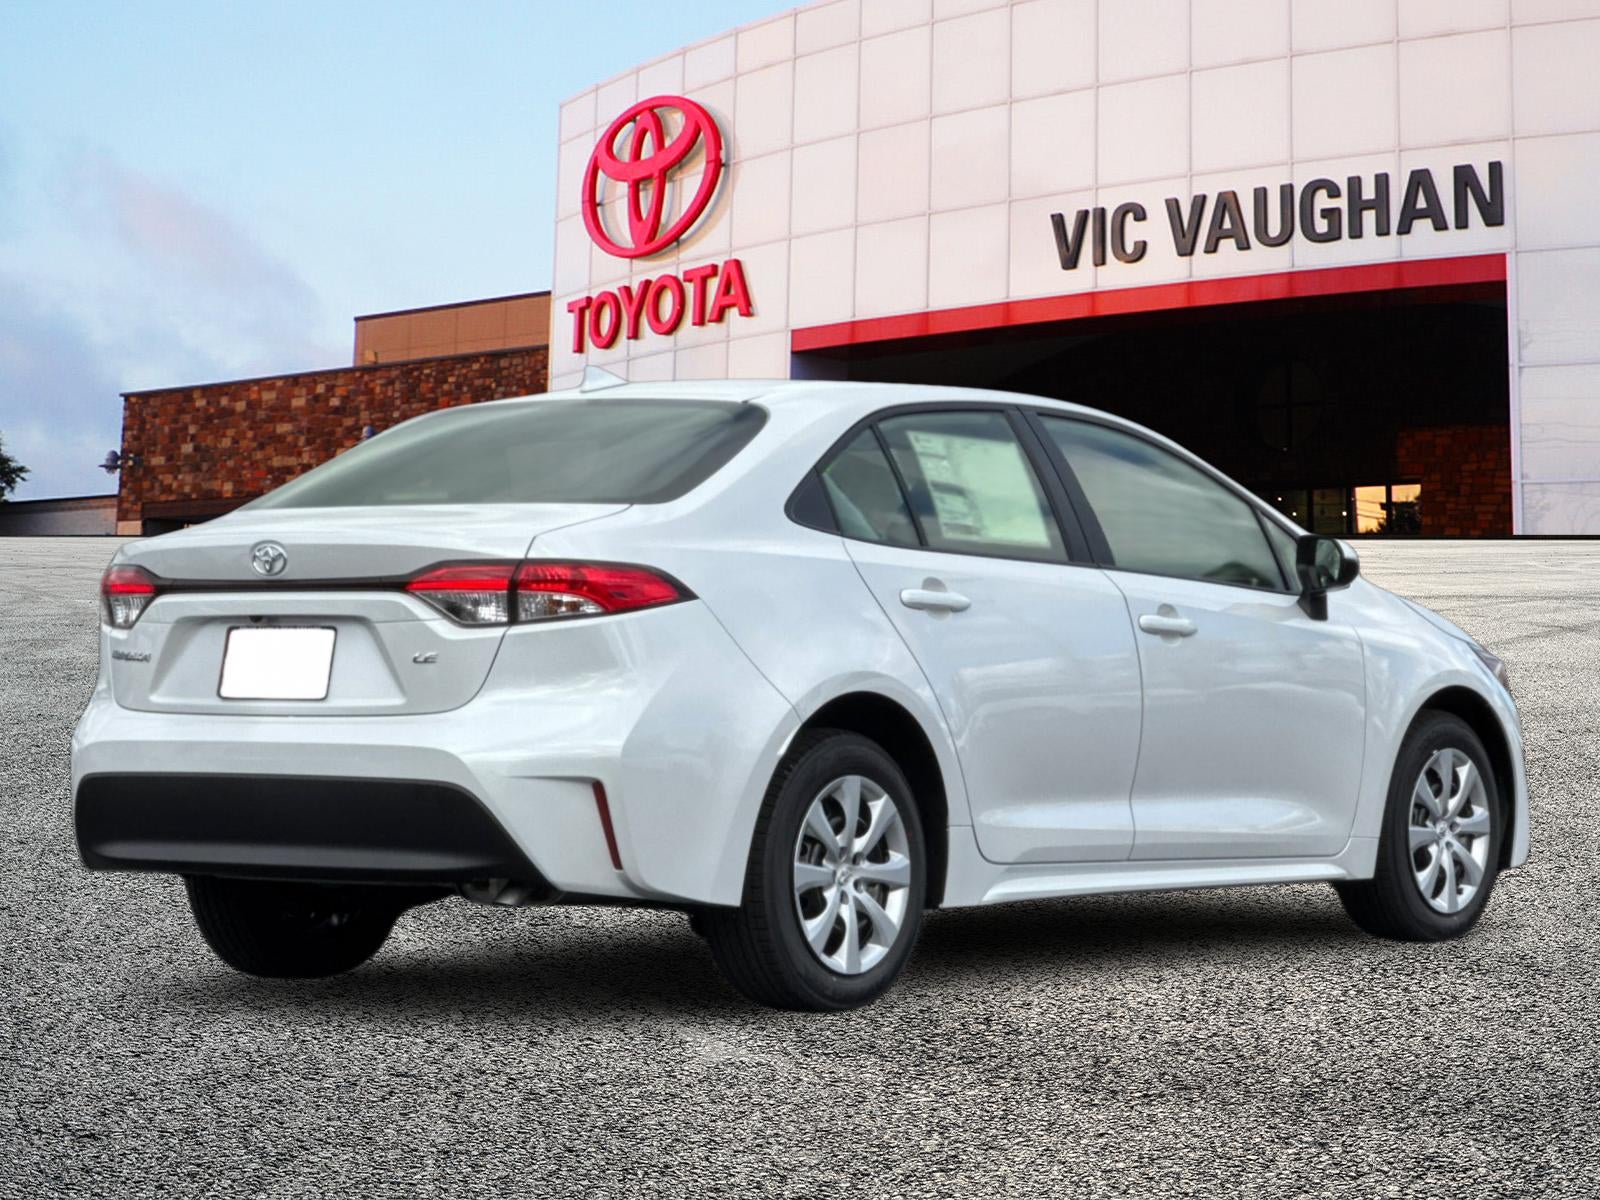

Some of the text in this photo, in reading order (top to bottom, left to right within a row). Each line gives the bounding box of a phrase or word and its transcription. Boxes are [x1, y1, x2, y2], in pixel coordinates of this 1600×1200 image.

[1050, 161, 1505, 270] VIC VAUGHAN
[567, 258, 754, 354] TOYOTA
